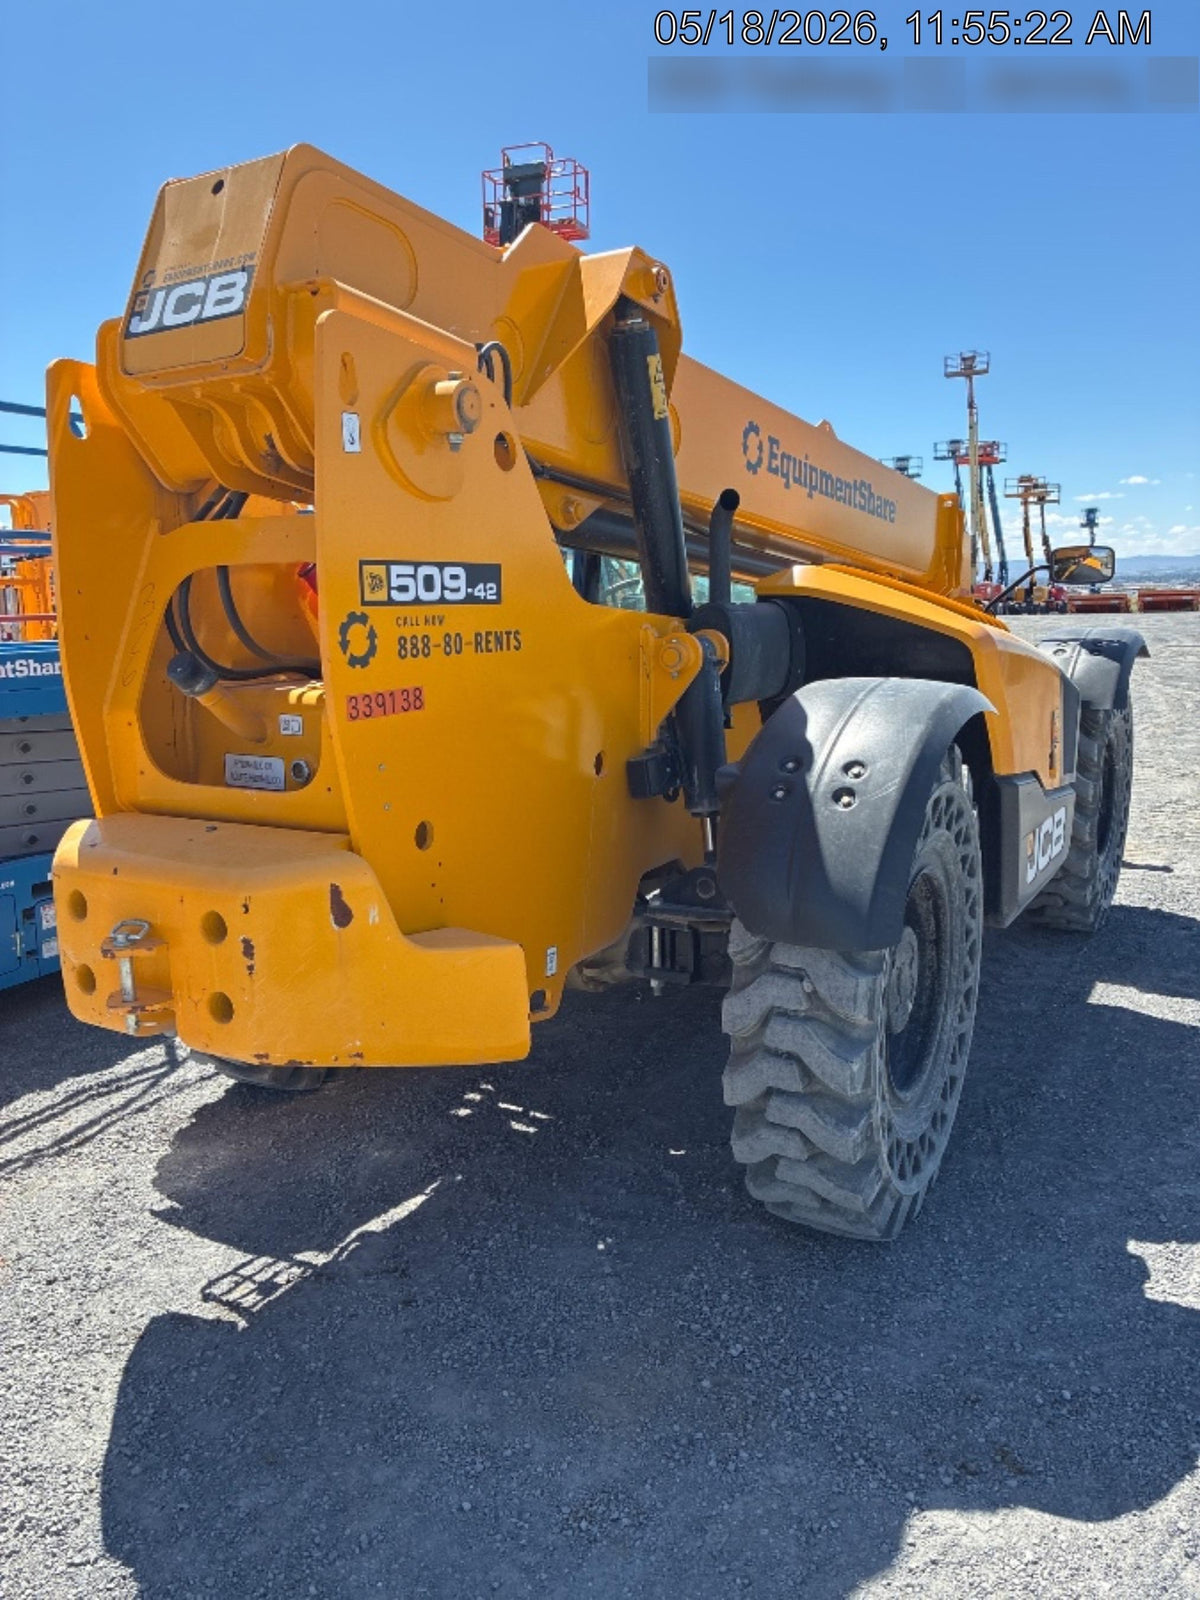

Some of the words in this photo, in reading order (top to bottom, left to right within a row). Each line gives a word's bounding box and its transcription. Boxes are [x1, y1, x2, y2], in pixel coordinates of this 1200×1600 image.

[129, 271, 248, 333] JCB
[767, 435, 897, 523] EquipmentShare
[389, 564, 498, 602] 509-42
[396, 616, 420, 627] CALL
[424, 615, 445, 627] NOW
[397, 630, 522, 660] 888-80-RENTS
[349, 687, 424, 720] 339138
[1026, 806, 1067, 885] JCB
